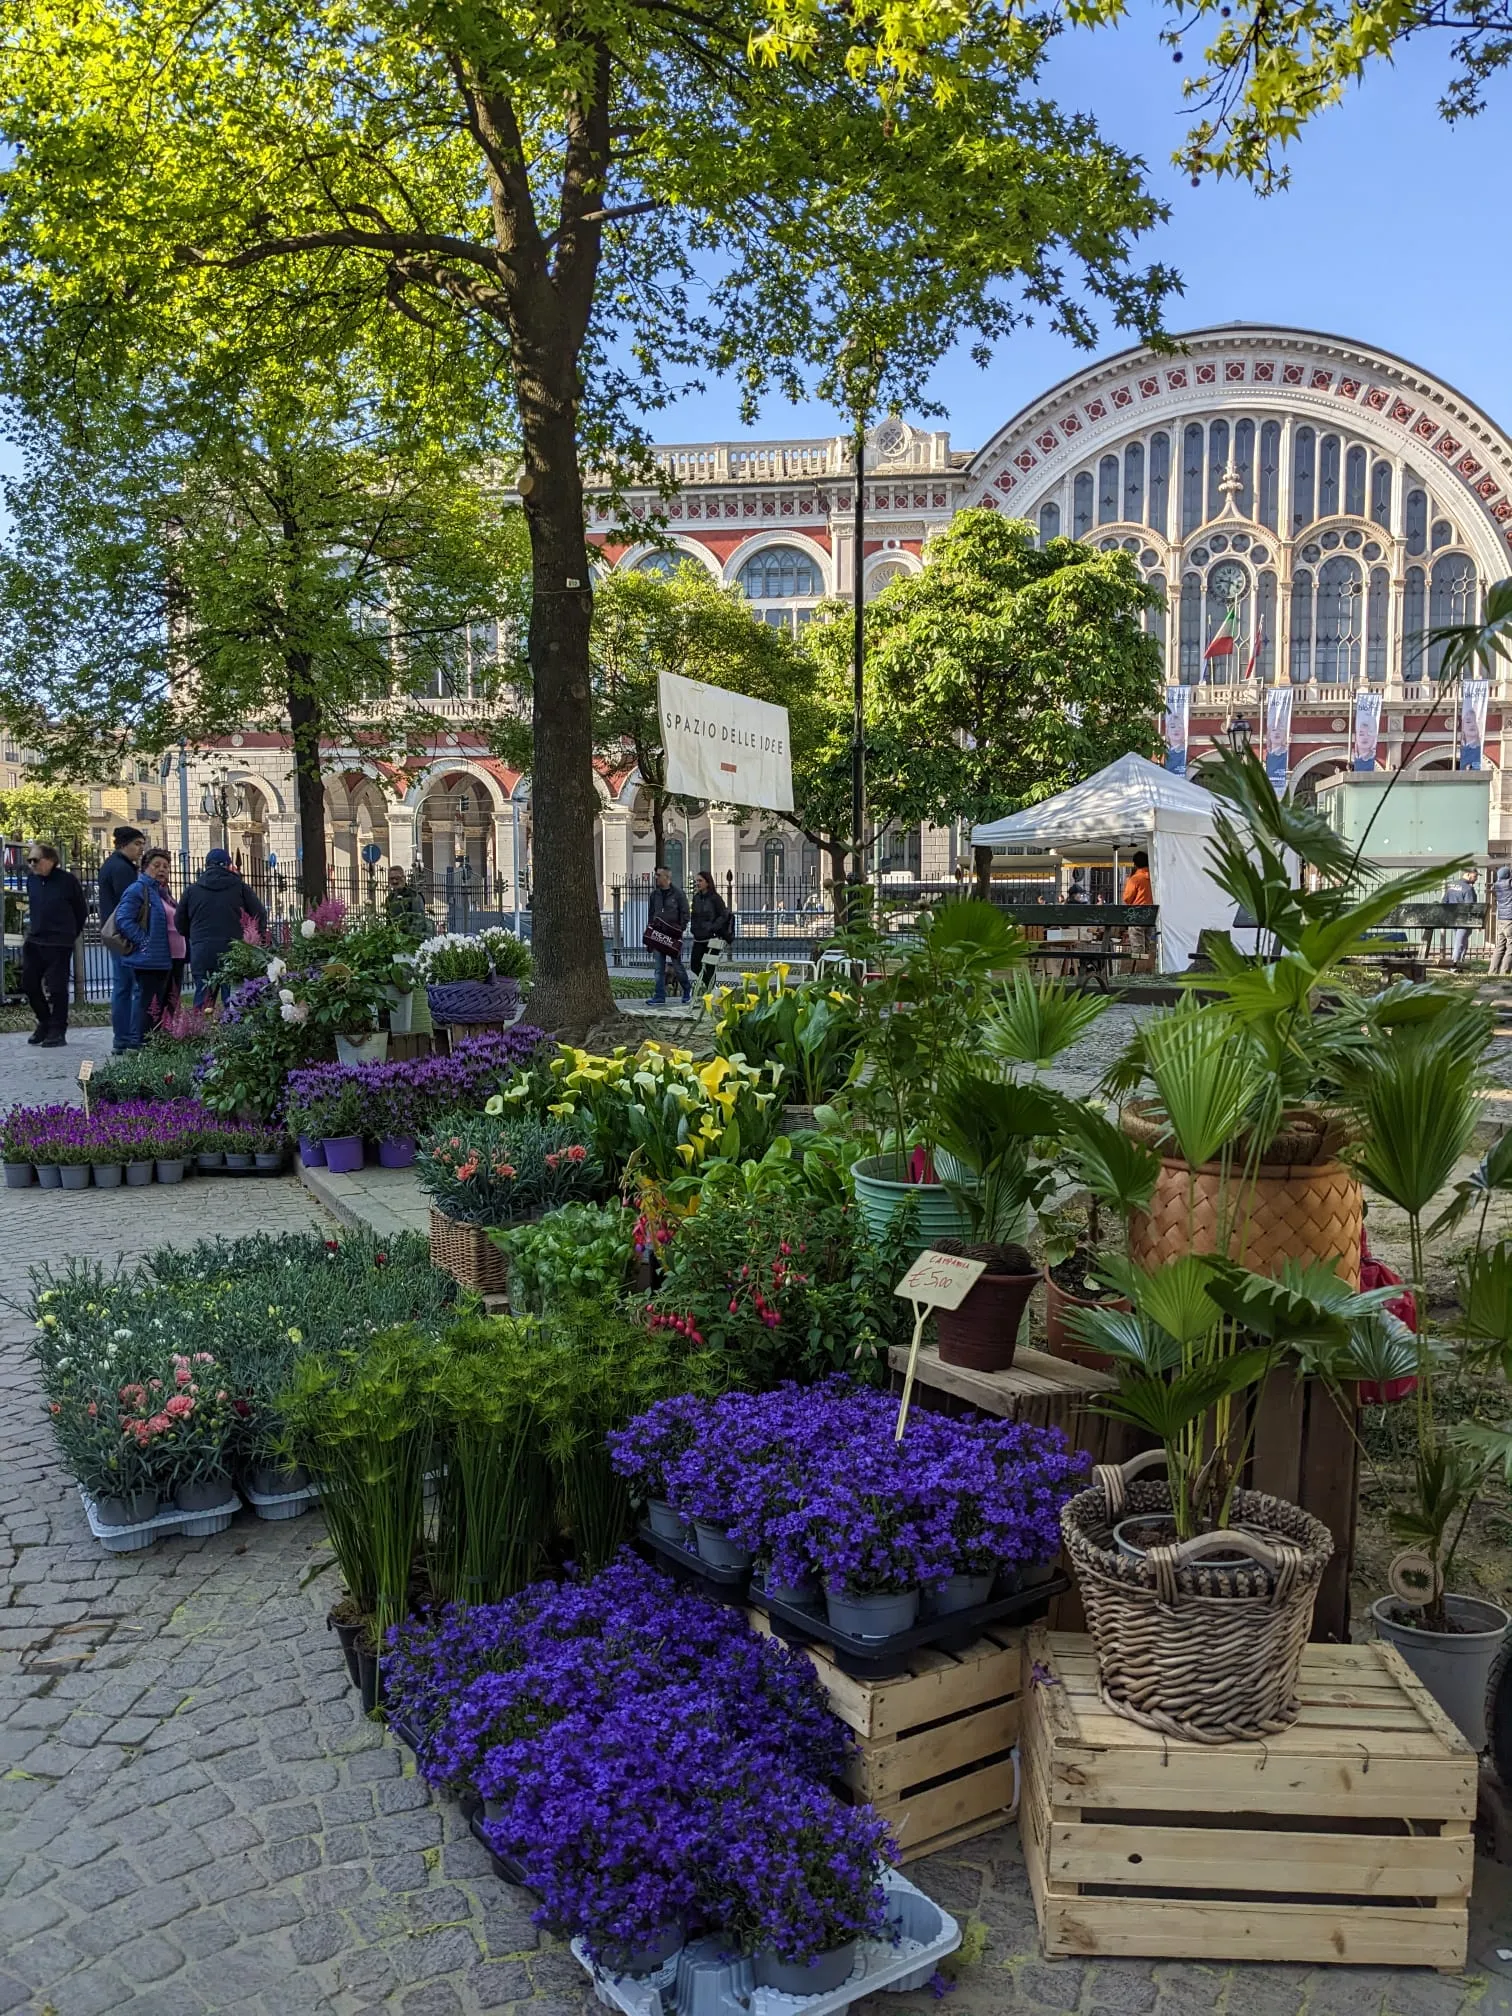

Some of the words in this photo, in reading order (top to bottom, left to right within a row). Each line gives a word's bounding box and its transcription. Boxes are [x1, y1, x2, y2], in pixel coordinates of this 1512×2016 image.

[666, 712, 717, 737] SPAZIO
[722, 726, 755, 748] DELLE
[760, 735, 784, 755] IDEE
